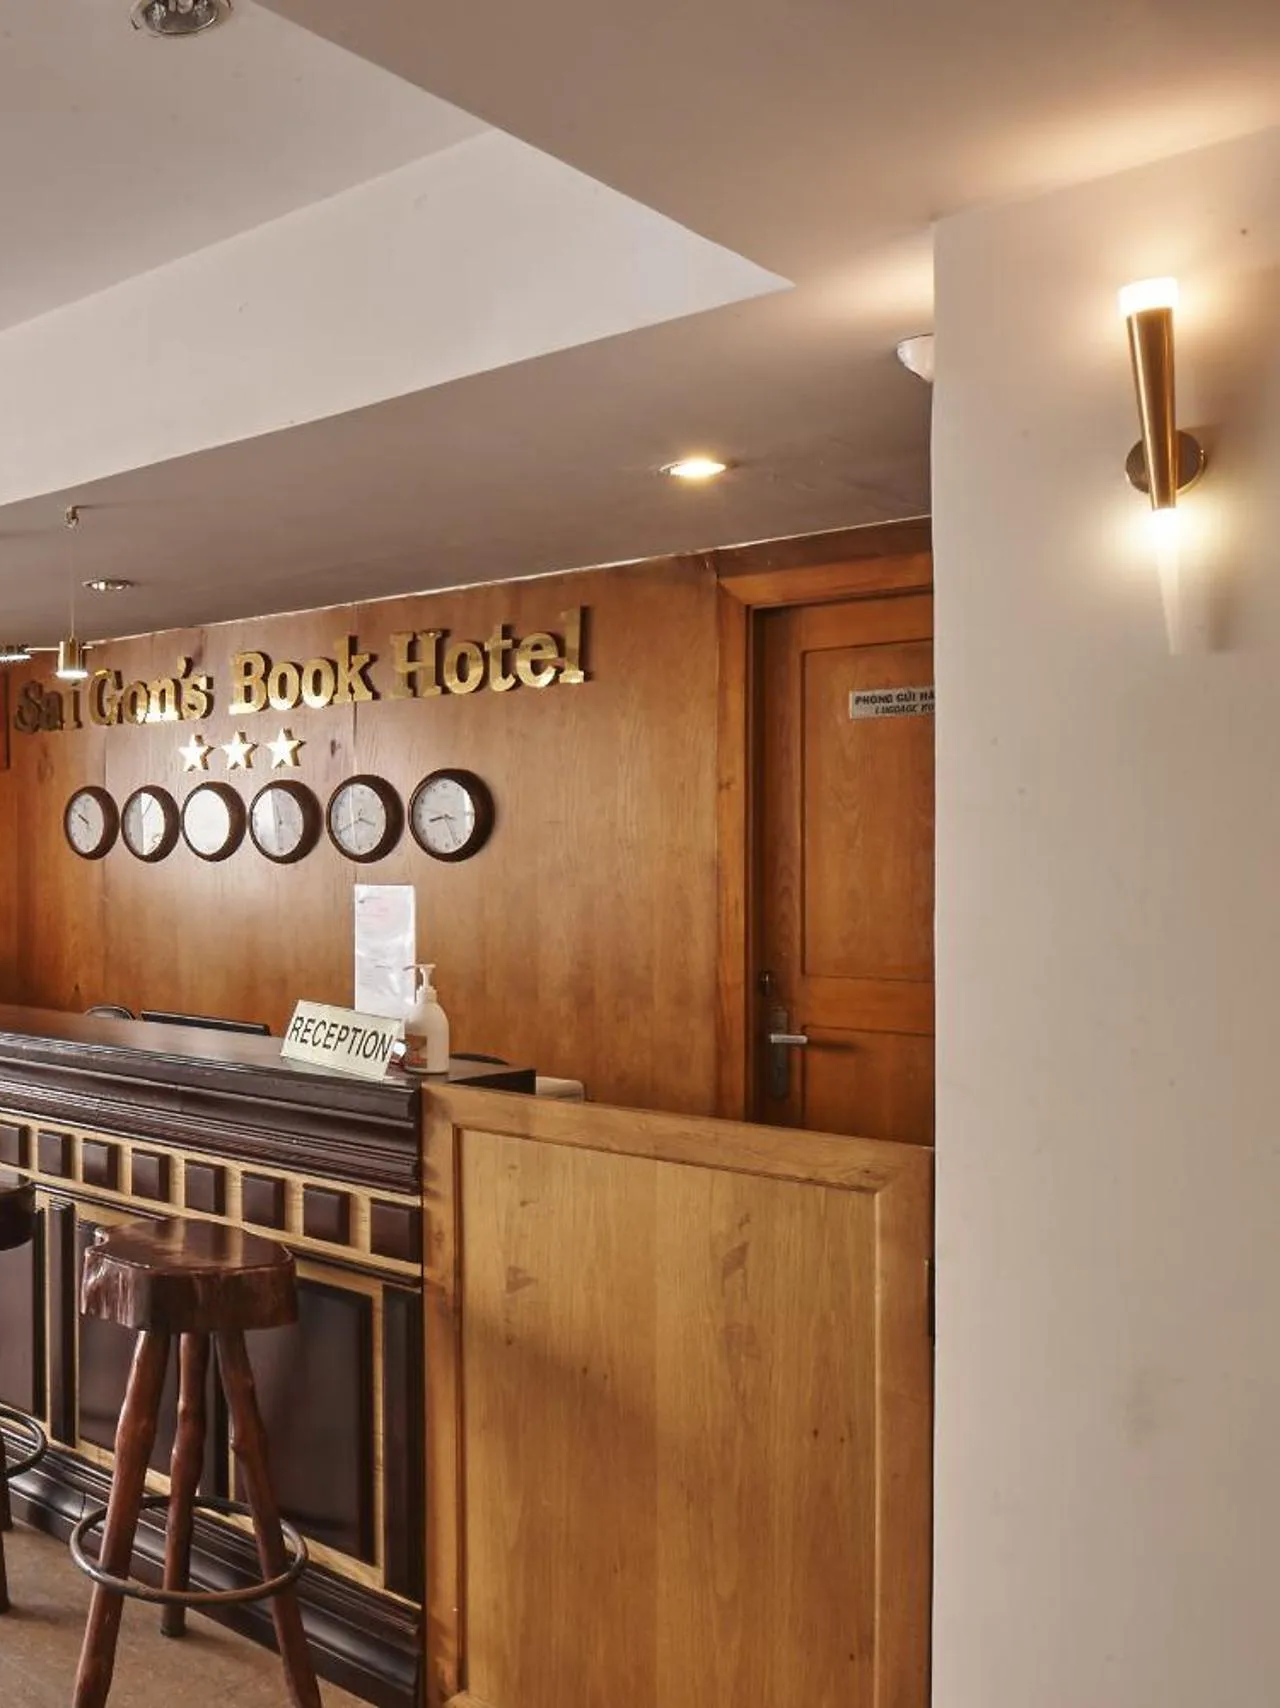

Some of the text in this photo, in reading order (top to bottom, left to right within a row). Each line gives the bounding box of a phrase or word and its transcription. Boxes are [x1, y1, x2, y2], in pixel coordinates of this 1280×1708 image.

[228, 634, 380, 715] Book
[390, 605, 593, 700] Hotel
[288, 1015, 393, 1062] RECEPTION
